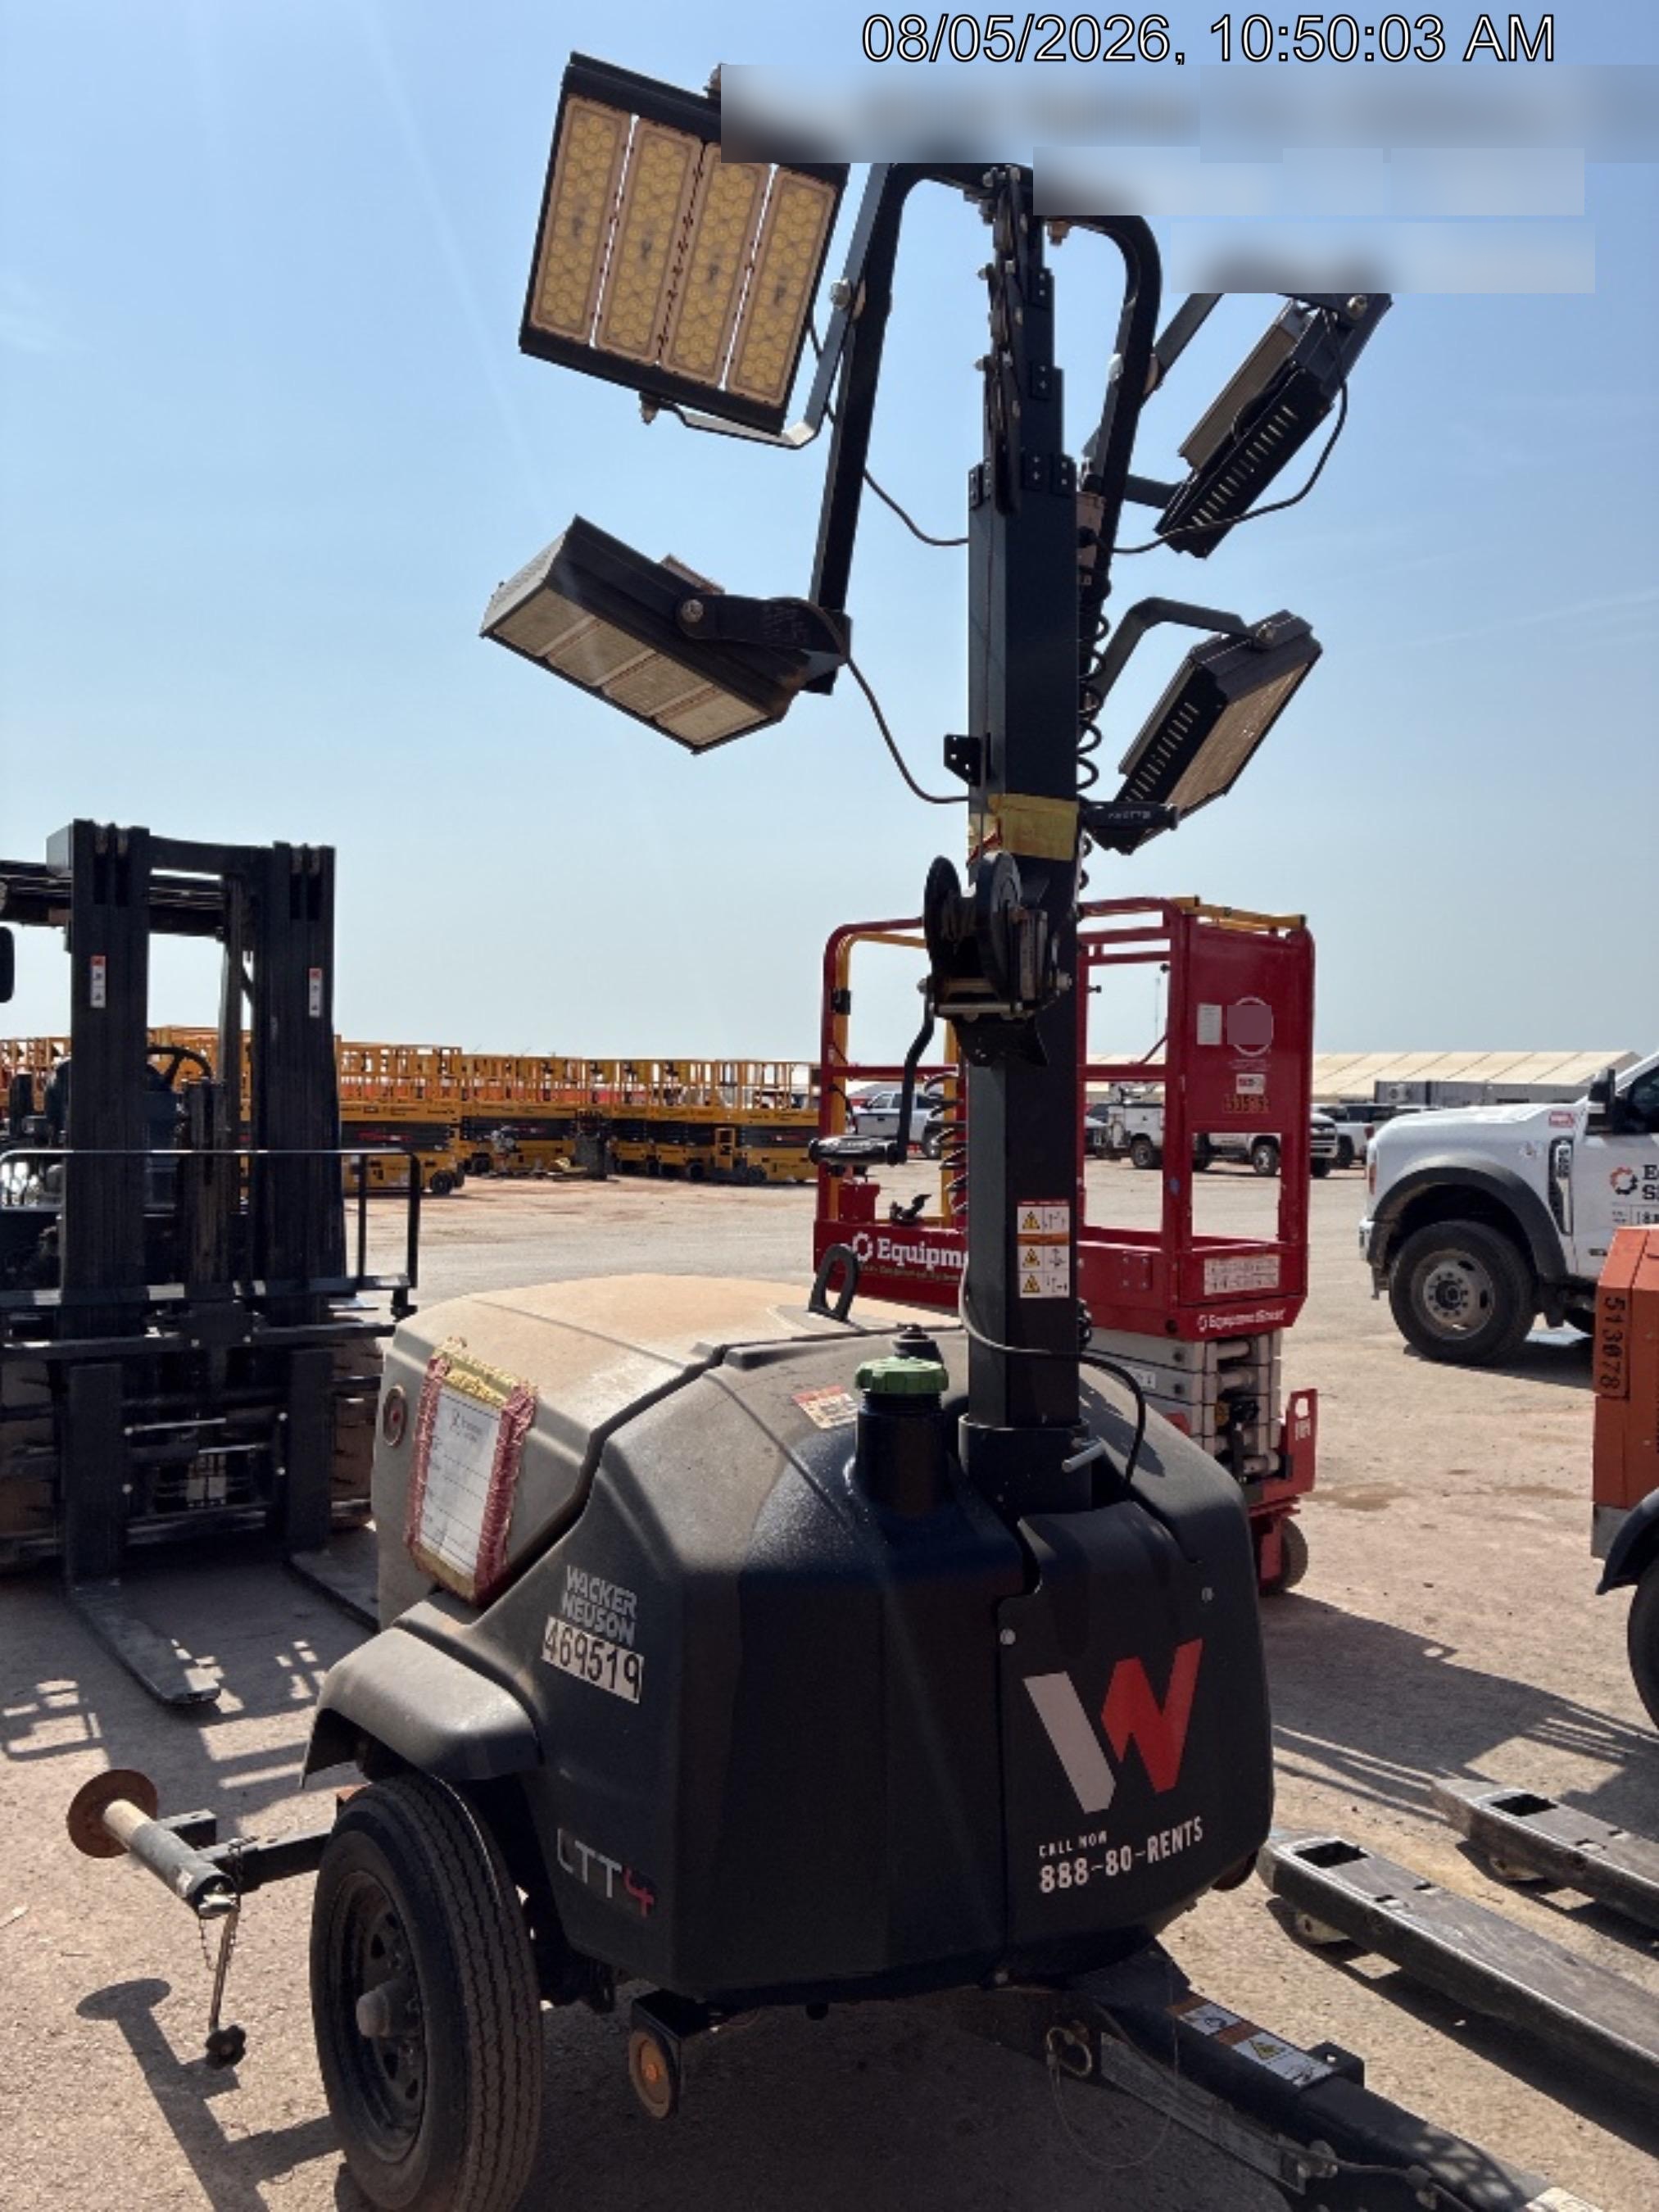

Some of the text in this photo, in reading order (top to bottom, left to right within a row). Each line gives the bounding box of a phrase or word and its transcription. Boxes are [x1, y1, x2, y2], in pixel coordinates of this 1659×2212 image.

[1642, 1184, 1659, 1201] S
[1643, 1163, 1659, 1181] E
[1599, 1297, 1625, 1389] 513078
[566, 1565, 638, 1619] WACKER
[561, 1592, 636, 1647] NEUSON
[544, 1622, 641, 1699] 469519
[1039, 1830, 1108, 1858] CALL NOW
[1040, 1815, 1204, 1894] 888-80-RENTS
